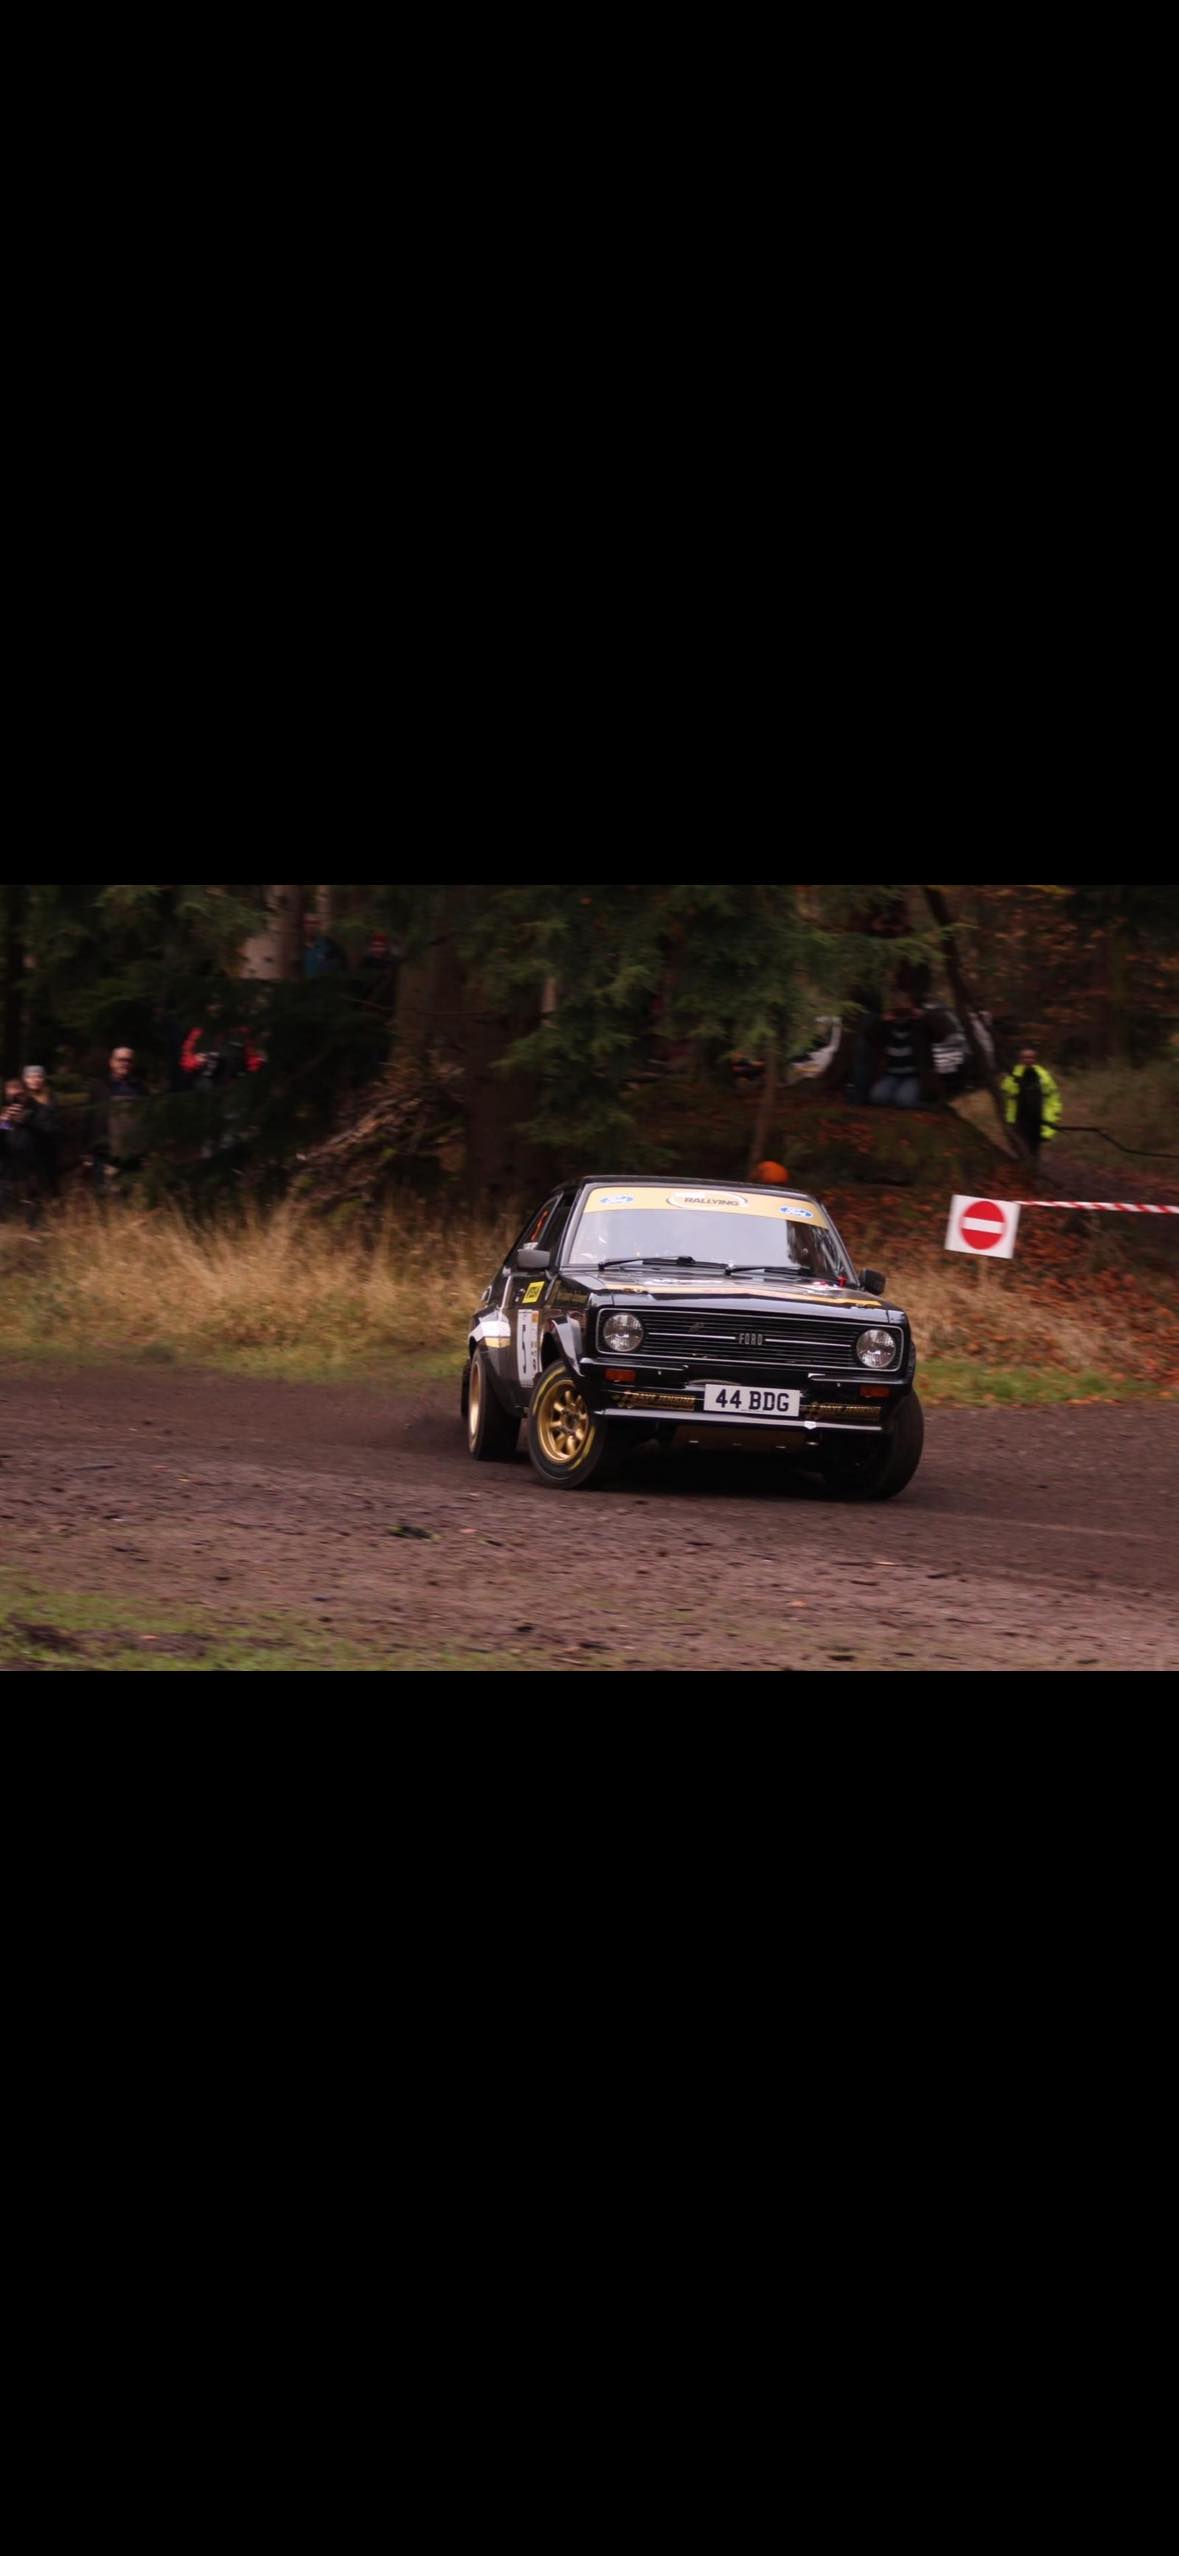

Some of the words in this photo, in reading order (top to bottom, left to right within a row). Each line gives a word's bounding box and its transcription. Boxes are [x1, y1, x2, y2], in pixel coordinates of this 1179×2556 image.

[684, 1197, 740, 1207] RALLYING
[738, 1332, 763, 1346] FORD
[716, 1389, 742, 1409] 44
[749, 1391, 790, 1412] BDG
